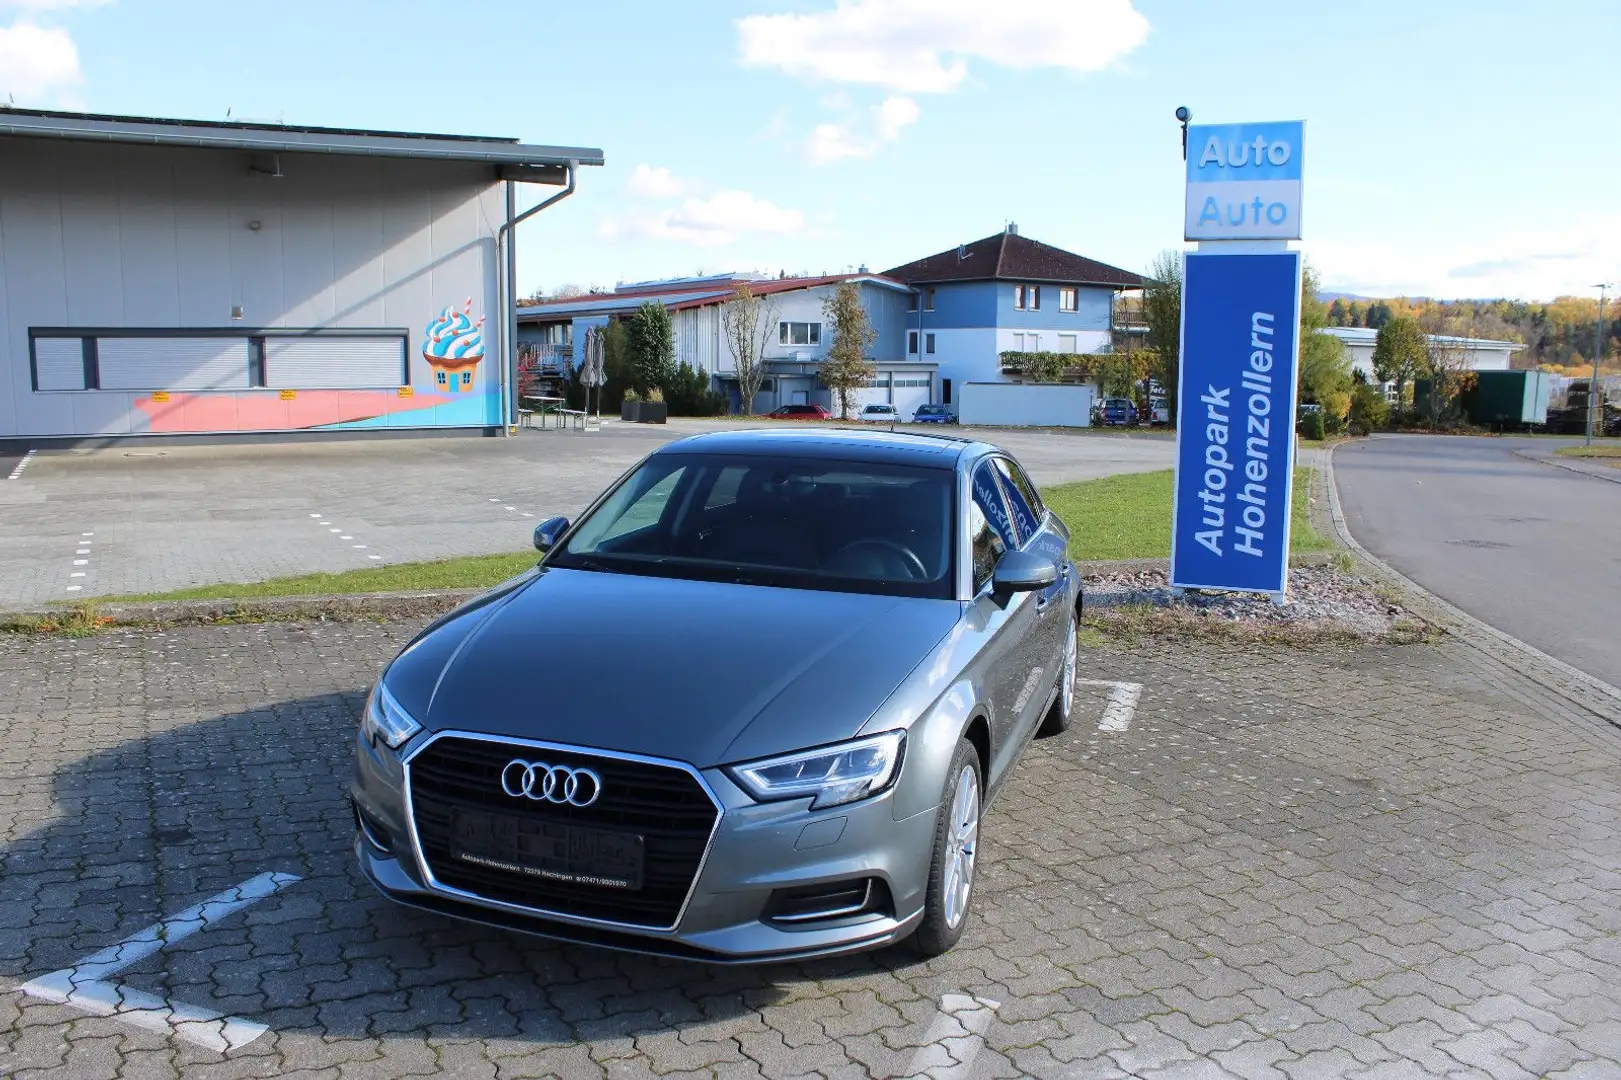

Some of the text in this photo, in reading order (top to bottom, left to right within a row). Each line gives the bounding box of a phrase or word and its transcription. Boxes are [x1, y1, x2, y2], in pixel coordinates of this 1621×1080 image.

[1198, 134, 1291, 168] Auto
[1197, 196, 1287, 226] Auto
[1194, 383, 1234, 557] Autopark
[1233, 311, 1275, 558] Hohenzollern
